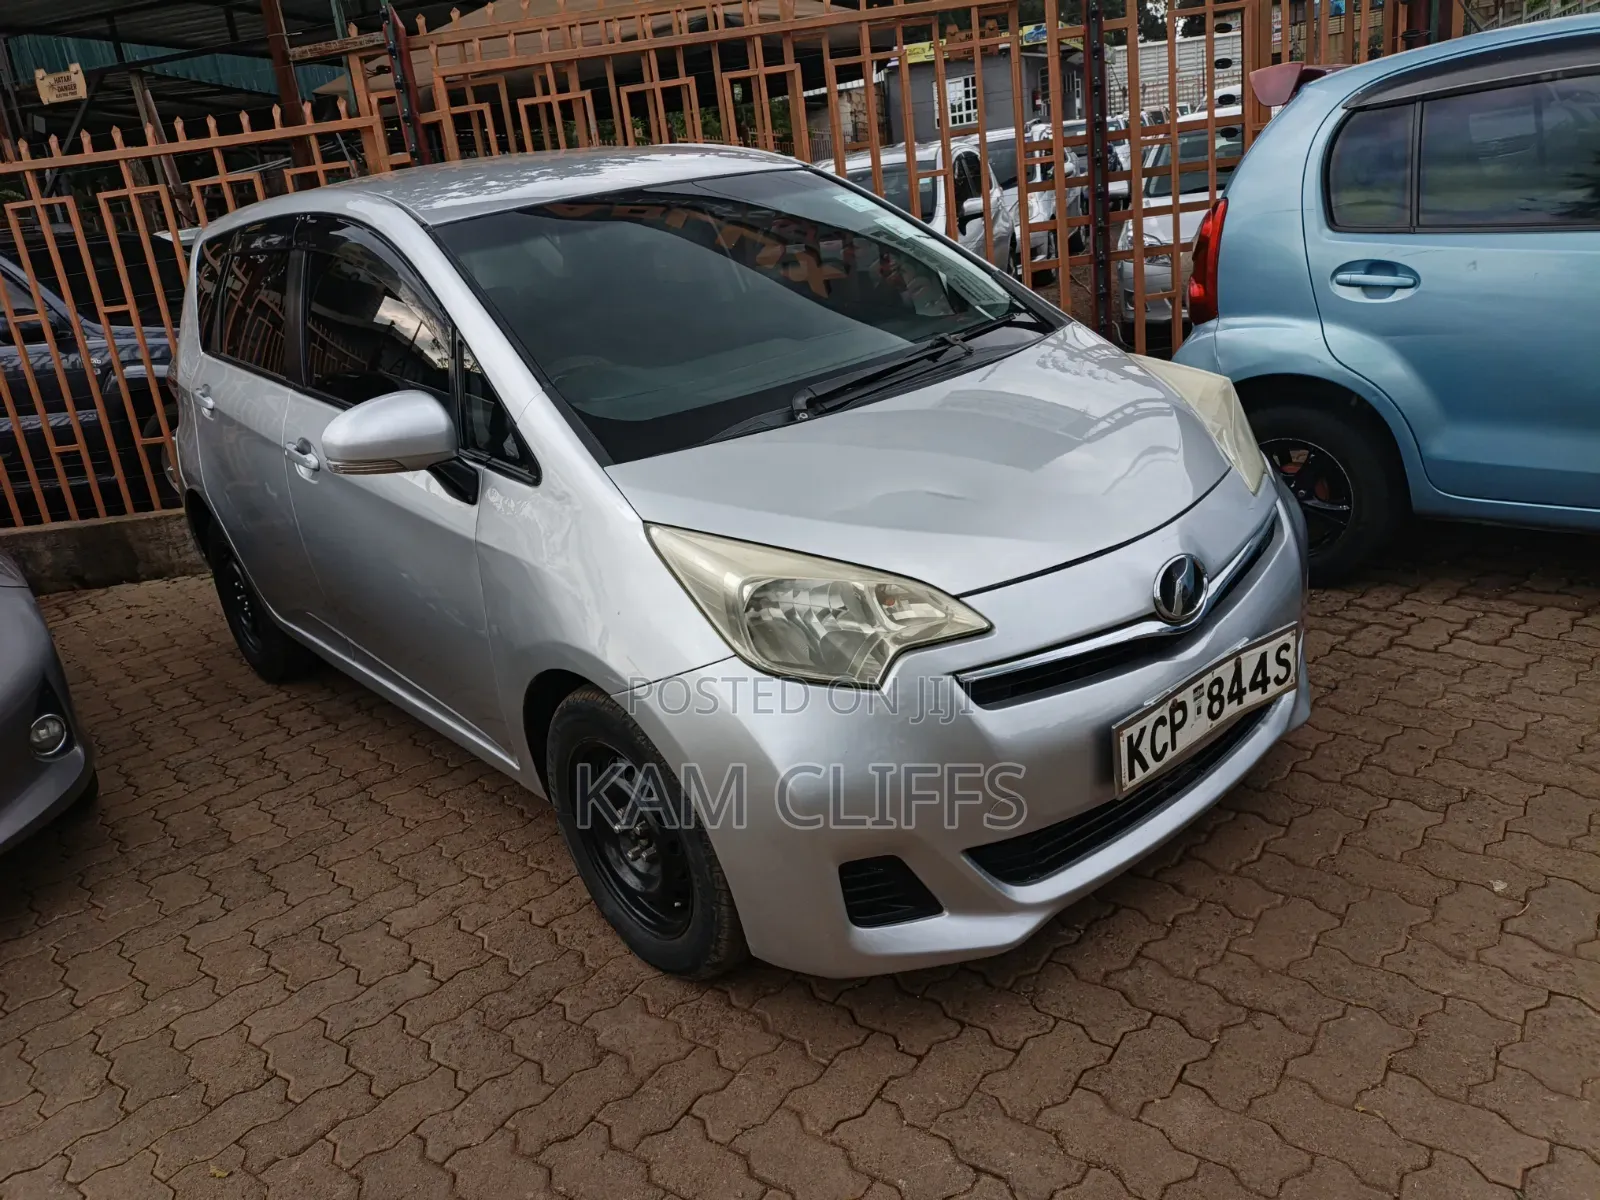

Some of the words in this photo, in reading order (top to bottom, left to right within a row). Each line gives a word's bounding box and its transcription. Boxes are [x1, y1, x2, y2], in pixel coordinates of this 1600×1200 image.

[54, 75, 71, 83] HATARI
[57, 84, 77, 92] DANGER
[1126, 700, 1188, 782] KCP
[1206, 642, 1292, 721] 844S
